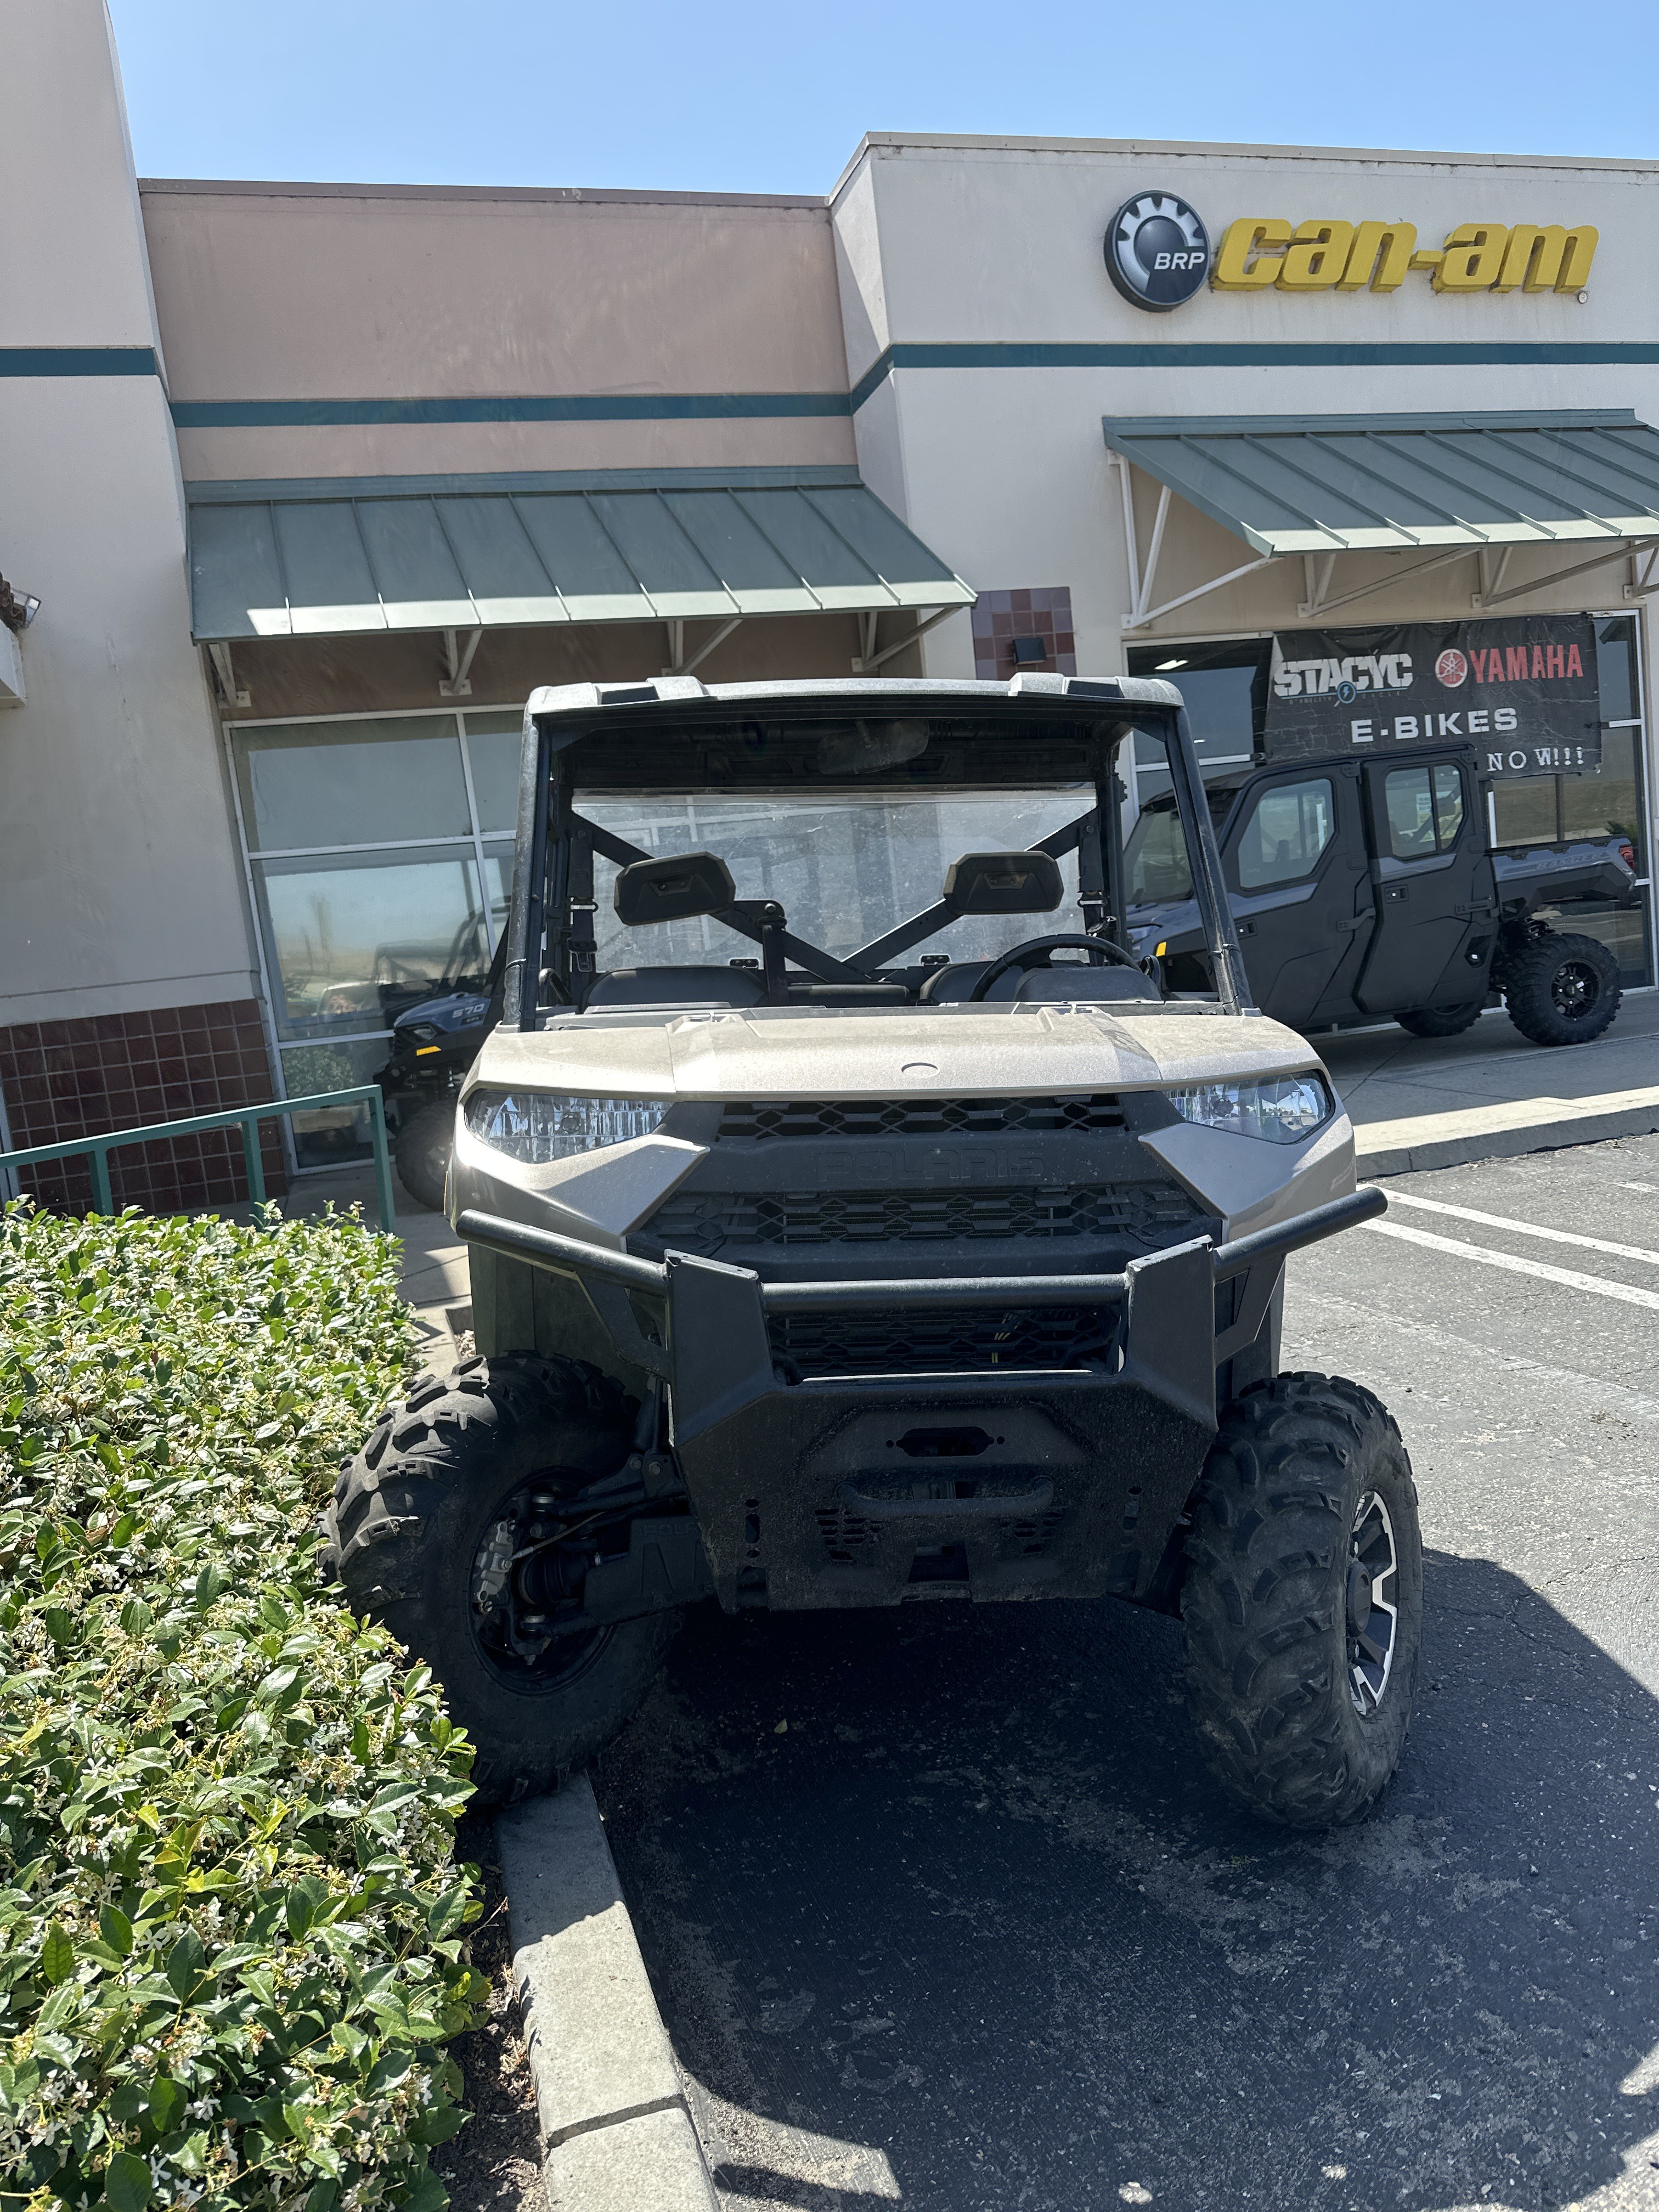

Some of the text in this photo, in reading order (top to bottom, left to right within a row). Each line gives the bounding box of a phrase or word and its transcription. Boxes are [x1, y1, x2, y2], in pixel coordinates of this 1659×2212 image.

[1153, 251, 1206, 270] BRP
[1273, 653, 1414, 697] STACYC
[1469, 644, 1584, 684] YAMAHA
[818, 1147, 1044, 1182] POLARIS
